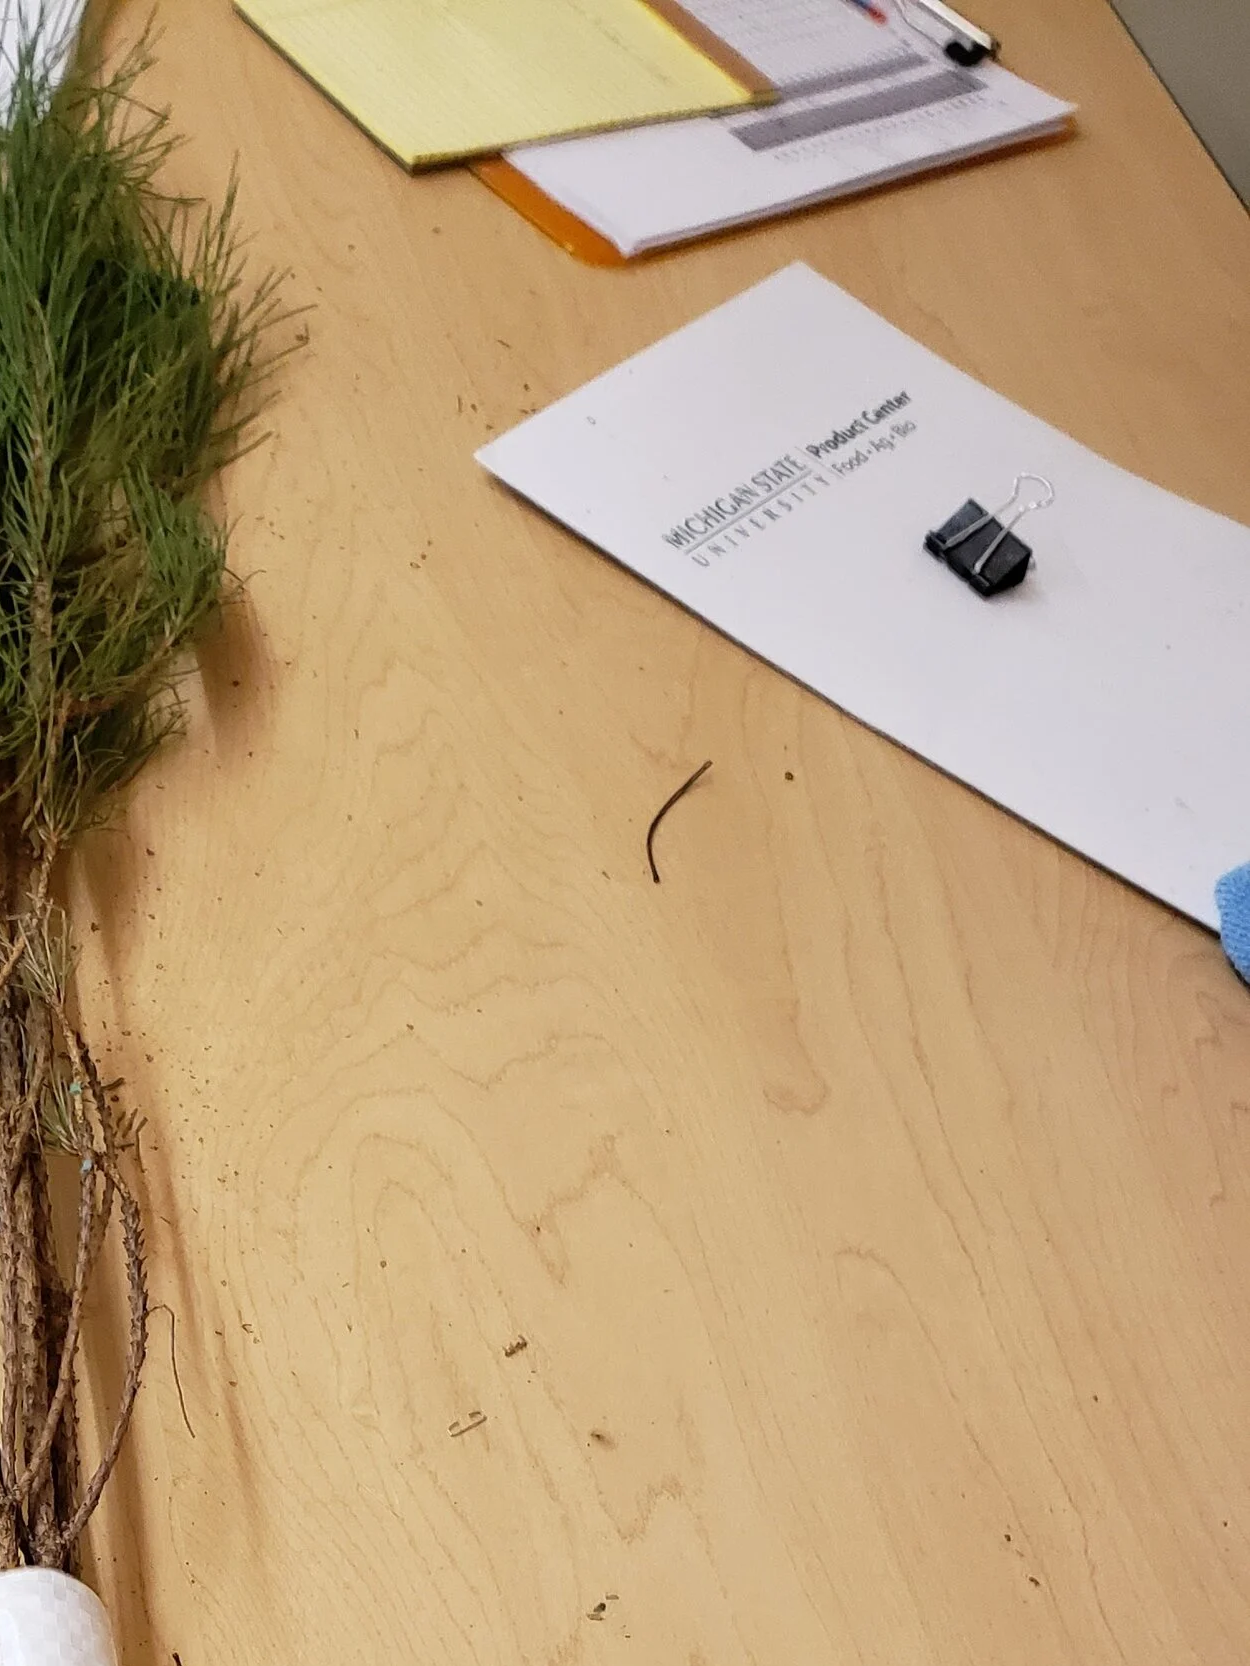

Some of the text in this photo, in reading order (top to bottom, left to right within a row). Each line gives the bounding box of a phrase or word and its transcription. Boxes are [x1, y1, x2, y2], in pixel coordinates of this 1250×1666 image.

[805, 391, 912, 459] Product Center
[832, 449, 869, 477] Food
[661, 454, 807, 549] MICHIGAN STATE
[692, 473, 830, 567] UNIVERSITY
